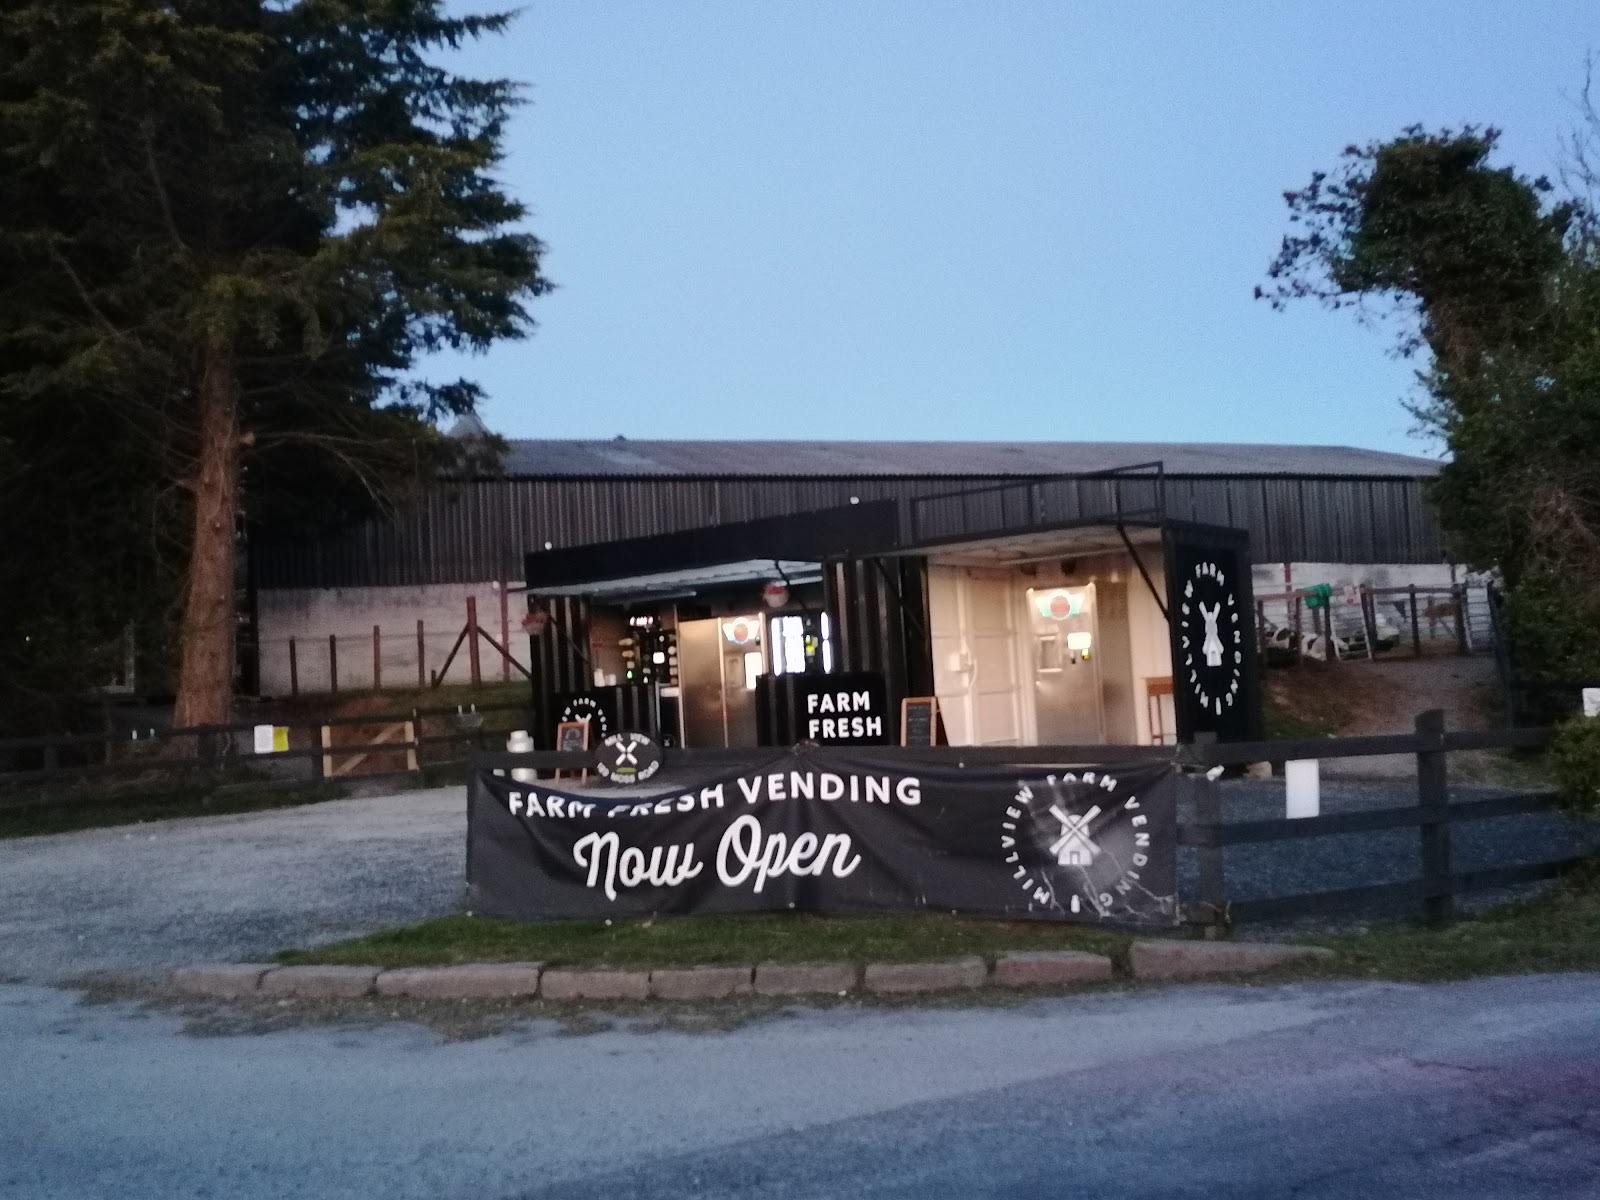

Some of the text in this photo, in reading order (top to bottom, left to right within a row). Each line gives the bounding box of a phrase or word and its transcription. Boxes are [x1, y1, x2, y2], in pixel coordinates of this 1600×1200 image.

[807, 690, 870, 714] FARM
[808, 716, 882, 739] FRESH
[508, 791, 596, 819] FARM
[737, 770, 922, 805] VENDING
[716, 814, 861, 892] Open
[1046, 772, 1118, 792] FARM
[1099, 796, 1150, 907] VENDING
